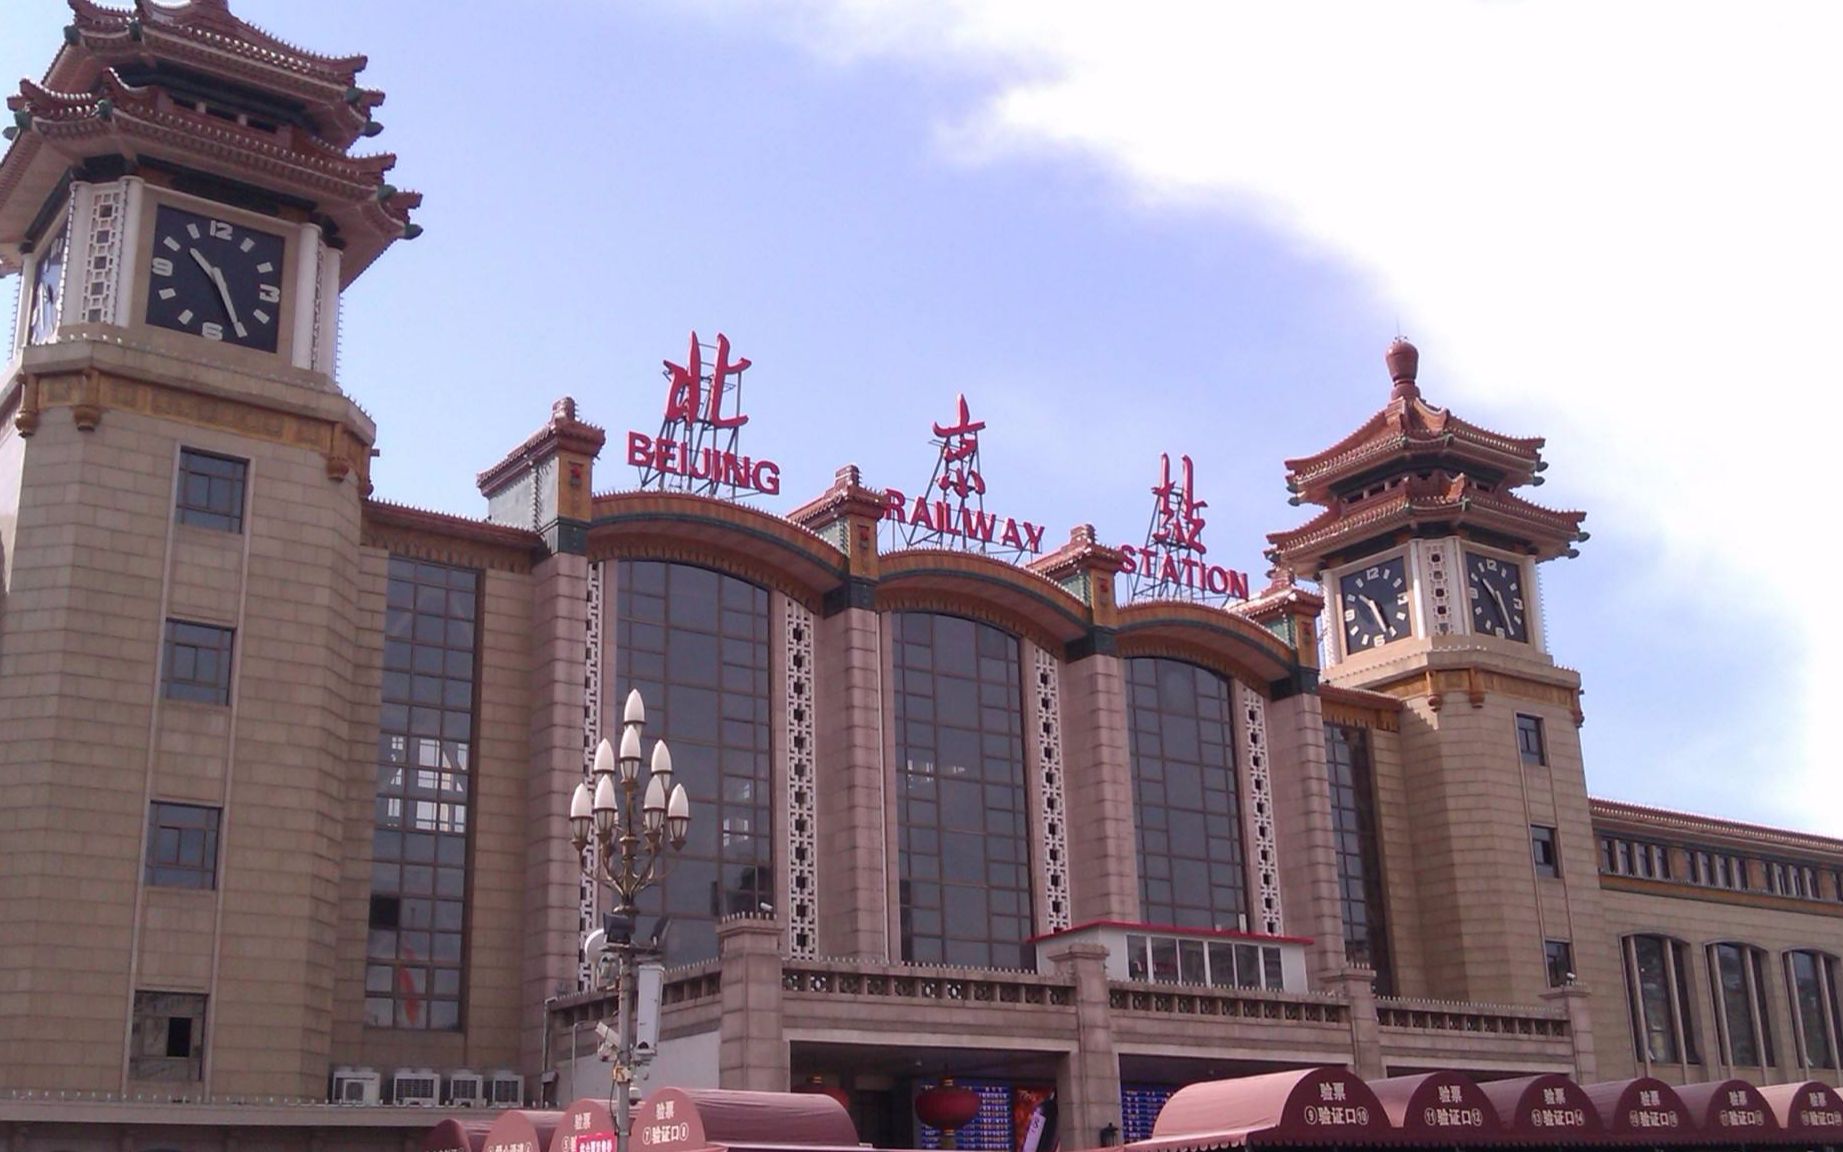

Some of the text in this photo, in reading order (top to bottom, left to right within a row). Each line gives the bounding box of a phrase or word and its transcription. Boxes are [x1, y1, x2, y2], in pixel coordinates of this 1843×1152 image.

[210, 220, 233, 241] 12
[152, 257, 173, 276] 9
[259, 284, 280, 303] 3
[202, 322, 224, 341] 6
[627, 431, 1249, 600] BEIJING RAILWAY STATION
[1366, 567, 1380, 581] 12
[1397, 592, 1408, 605] 3
[1345, 608, 1356, 622] 9
[1373, 634, 1385, 648] 6
[1319, 1082, 1346, 1101] 验票
[1437, 1085, 1462, 1103] 验票
[1543, 1087, 1566, 1105] 验票
[655, 1100, 675, 1120] 验票
